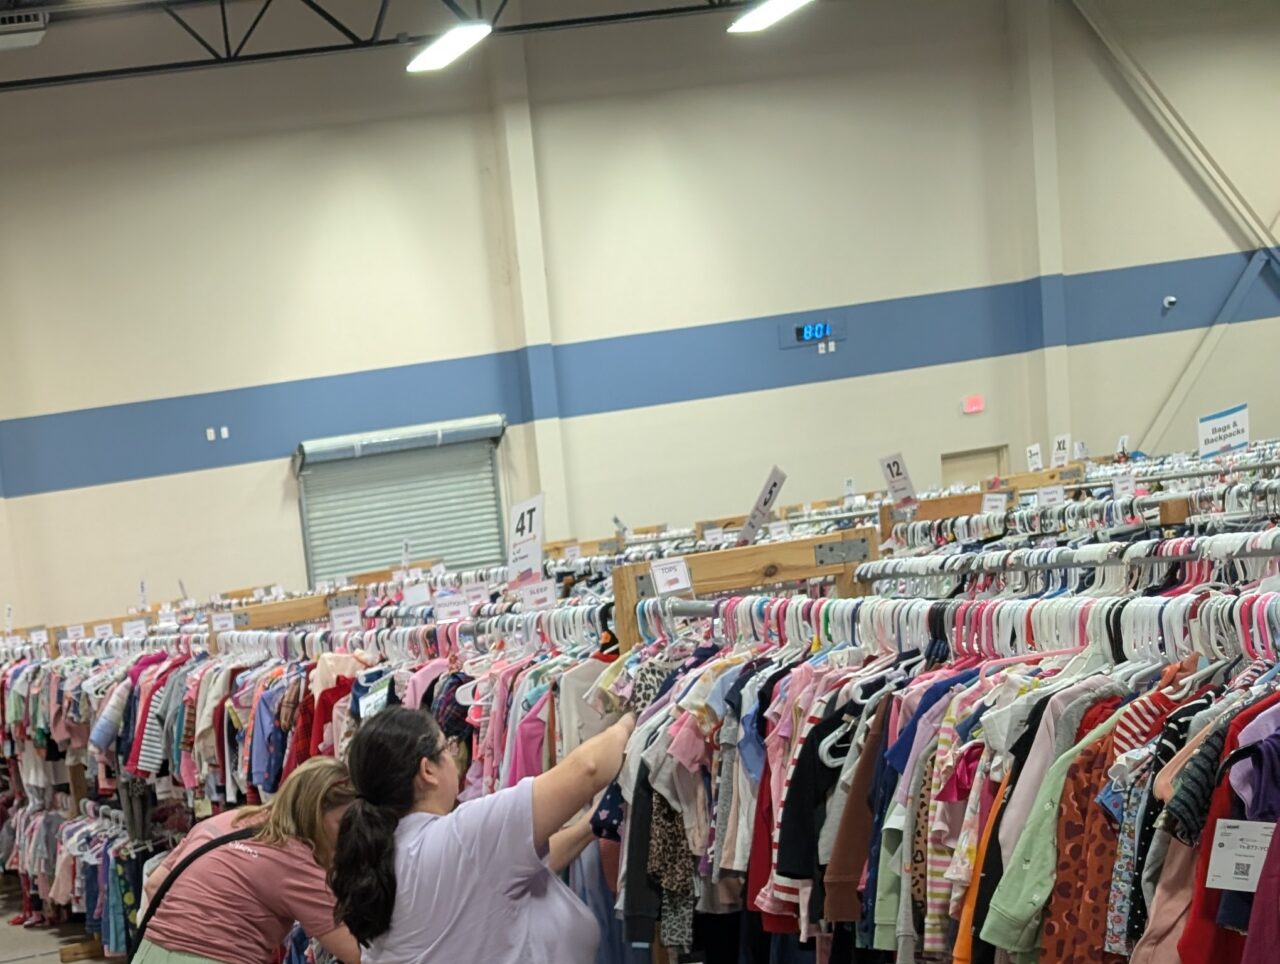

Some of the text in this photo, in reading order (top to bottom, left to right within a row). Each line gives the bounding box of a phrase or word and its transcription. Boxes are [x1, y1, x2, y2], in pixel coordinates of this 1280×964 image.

[1204, 427, 1245, 446] Backpacks
[1211, 424, 1231, 435] Bags
[1056, 440, 1067, 451] XL
[886, 460, 903, 479] 12
[763, 481, 778, 506] 5
[515, 507, 536, 537] 4T
